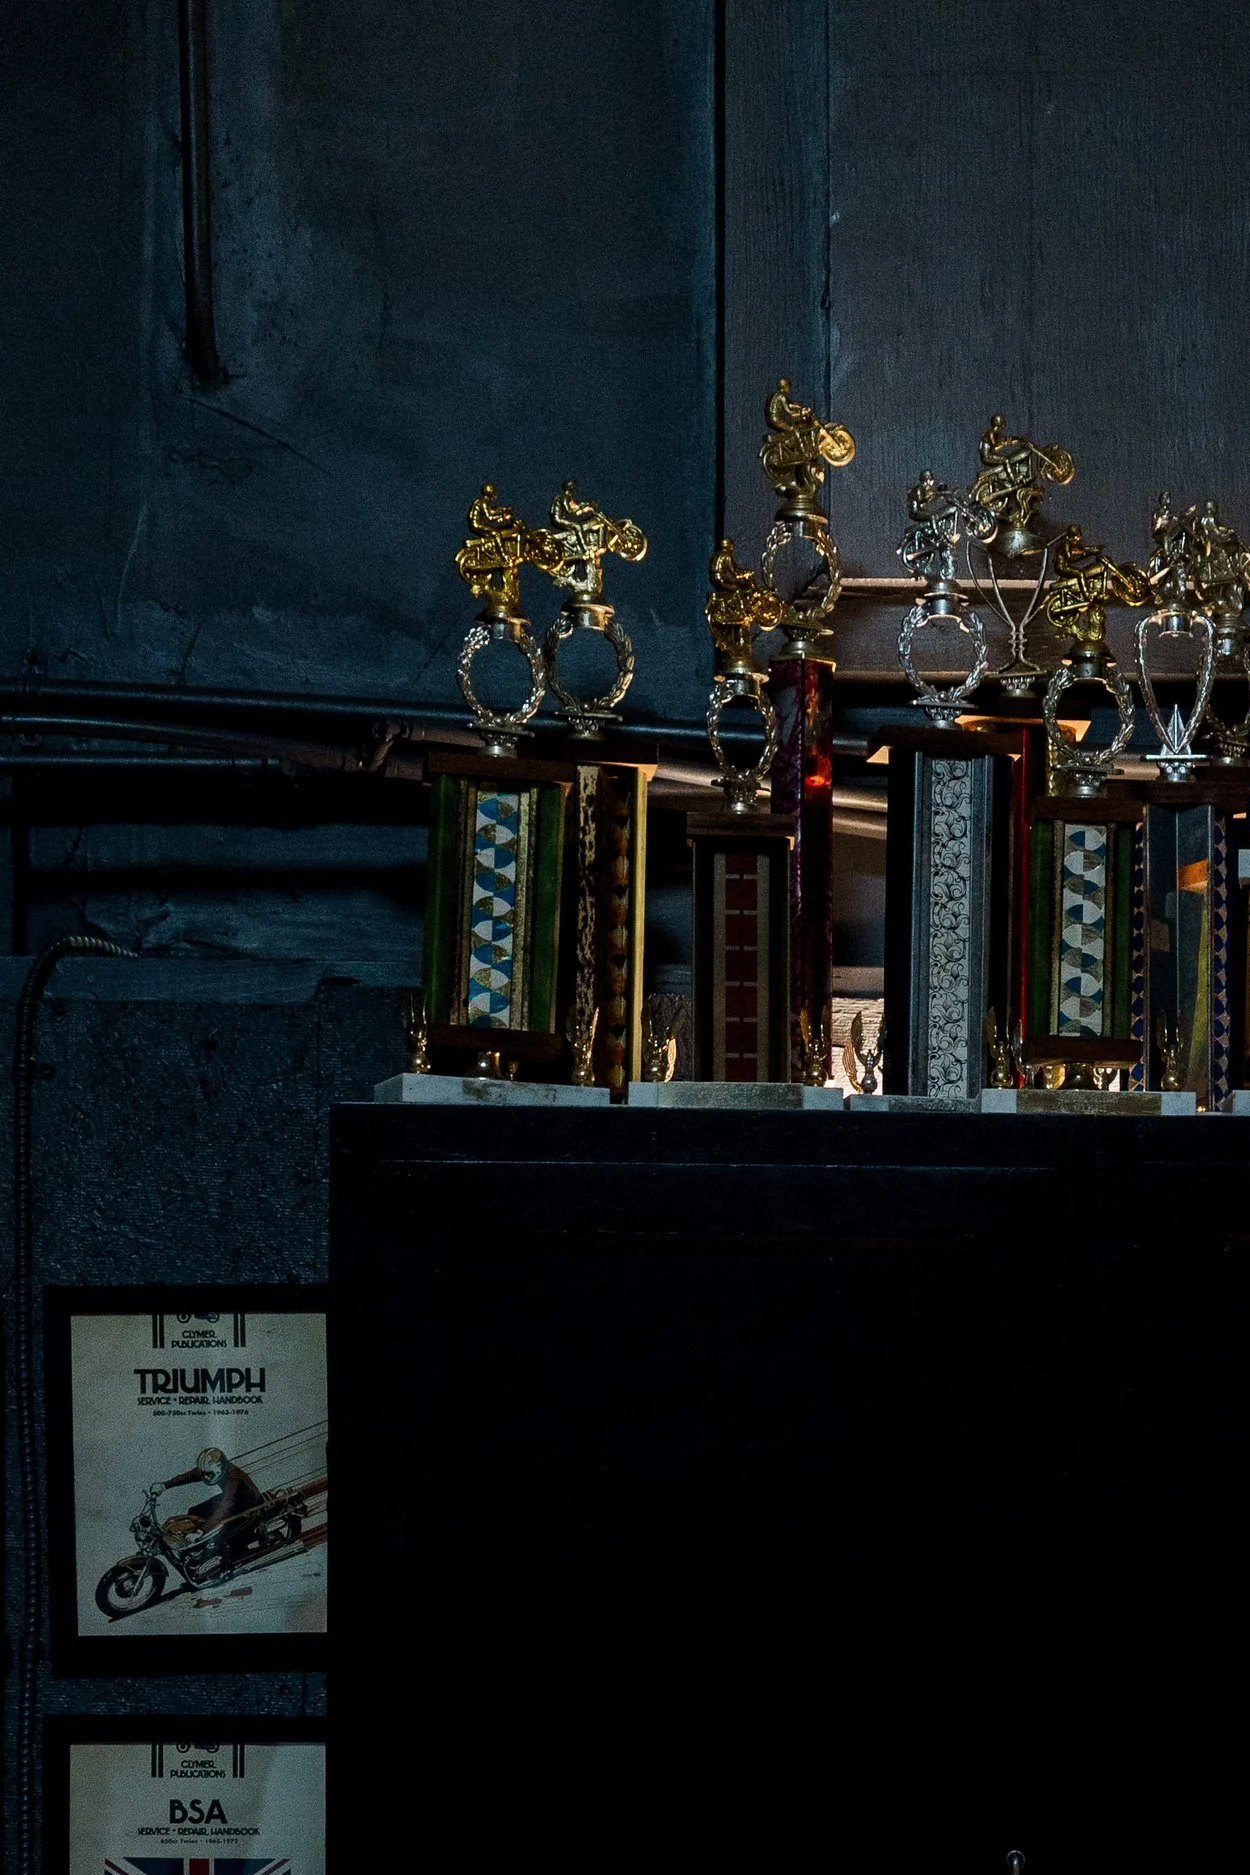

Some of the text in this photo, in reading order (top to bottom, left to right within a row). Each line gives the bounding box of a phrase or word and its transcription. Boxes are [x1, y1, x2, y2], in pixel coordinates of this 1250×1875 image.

[182, 1330, 217, 1339] CLYMER
[171, 1340, 227, 1348] PUBLICATIONS
[134, 1367, 266, 1394] TRIUMPH
[137, 1395, 264, 1406] SERVICE REPAIR HANDBOOK
[181, 1760, 217, 1769] CLYMER
[170, 1770, 226, 1778] PUBLICATIONS
[169, 1799, 228, 1824] BSA
[137, 1827, 260, 1836] SERVICE REPAIR HANDBOOK
